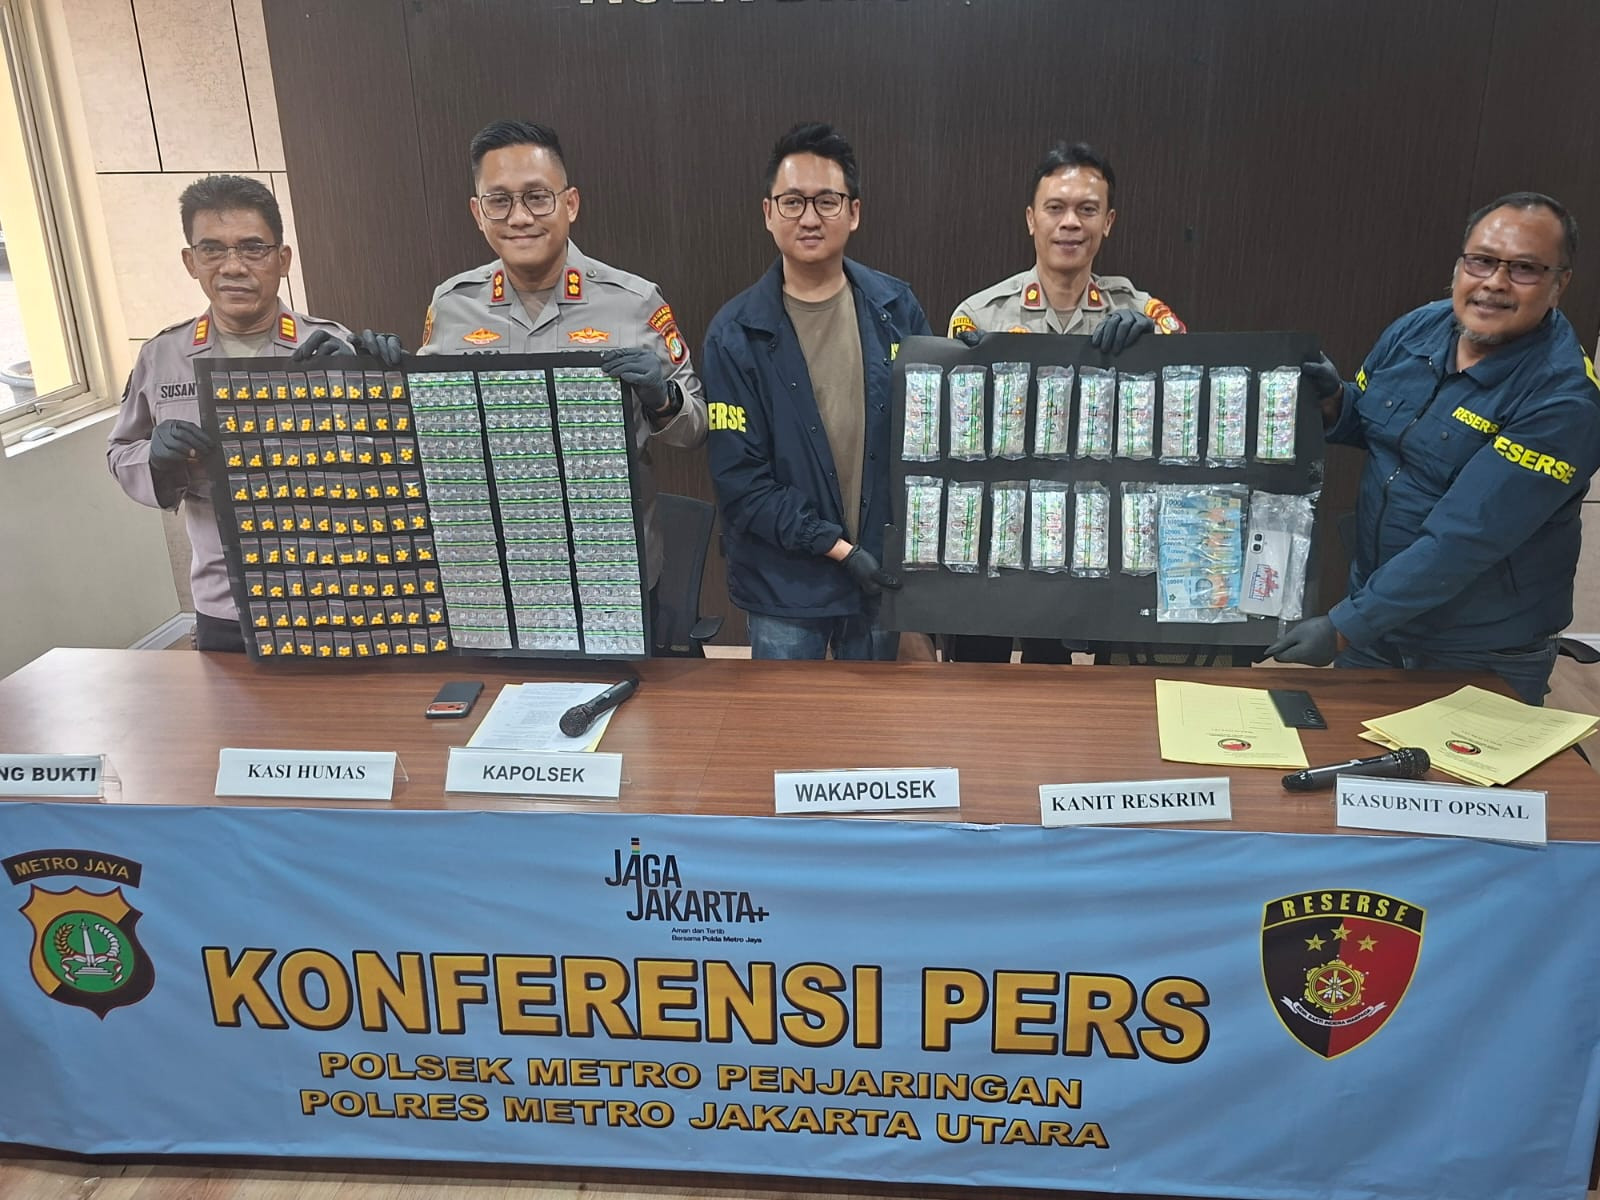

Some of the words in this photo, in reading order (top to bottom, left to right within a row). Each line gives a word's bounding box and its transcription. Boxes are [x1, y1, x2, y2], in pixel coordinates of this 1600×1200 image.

[31, 767, 97, 782] BUKTI
[247, 763, 291, 780] KASI
[297, 764, 366, 783] HUMAS
[483, 766, 586, 785] KAPOLSEK
[795, 780, 936, 803] WAKAPOLSEK
[1052, 795, 1116, 812] KANIT
[1121, 790, 1216, 812] RESKRIM
[1338, 791, 1443, 814] KASUBNIT
[1448, 801, 1530, 821] OPSNAL
[14, 857, 79, 877] METRO
[84, 859, 129, 880] JAYA
[605, 847, 682, 889] JAGA
[1281, 893, 1409, 922] RESERSE
[202, 946, 882, 1049] KONFERENSI
[921, 966, 1210, 1064] PERS
[319, 1051, 513, 1085] POLSEK
[527, 1057, 700, 1089] METRO
[717, 1064, 1081, 1109] PENJARINGAN
[300, 1089, 490, 1122] POLRES
[504, 1096, 674, 1128] METRO
[689, 1102, 921, 1140] JAKARTA
[935, 1111, 1110, 1149] UTARA
